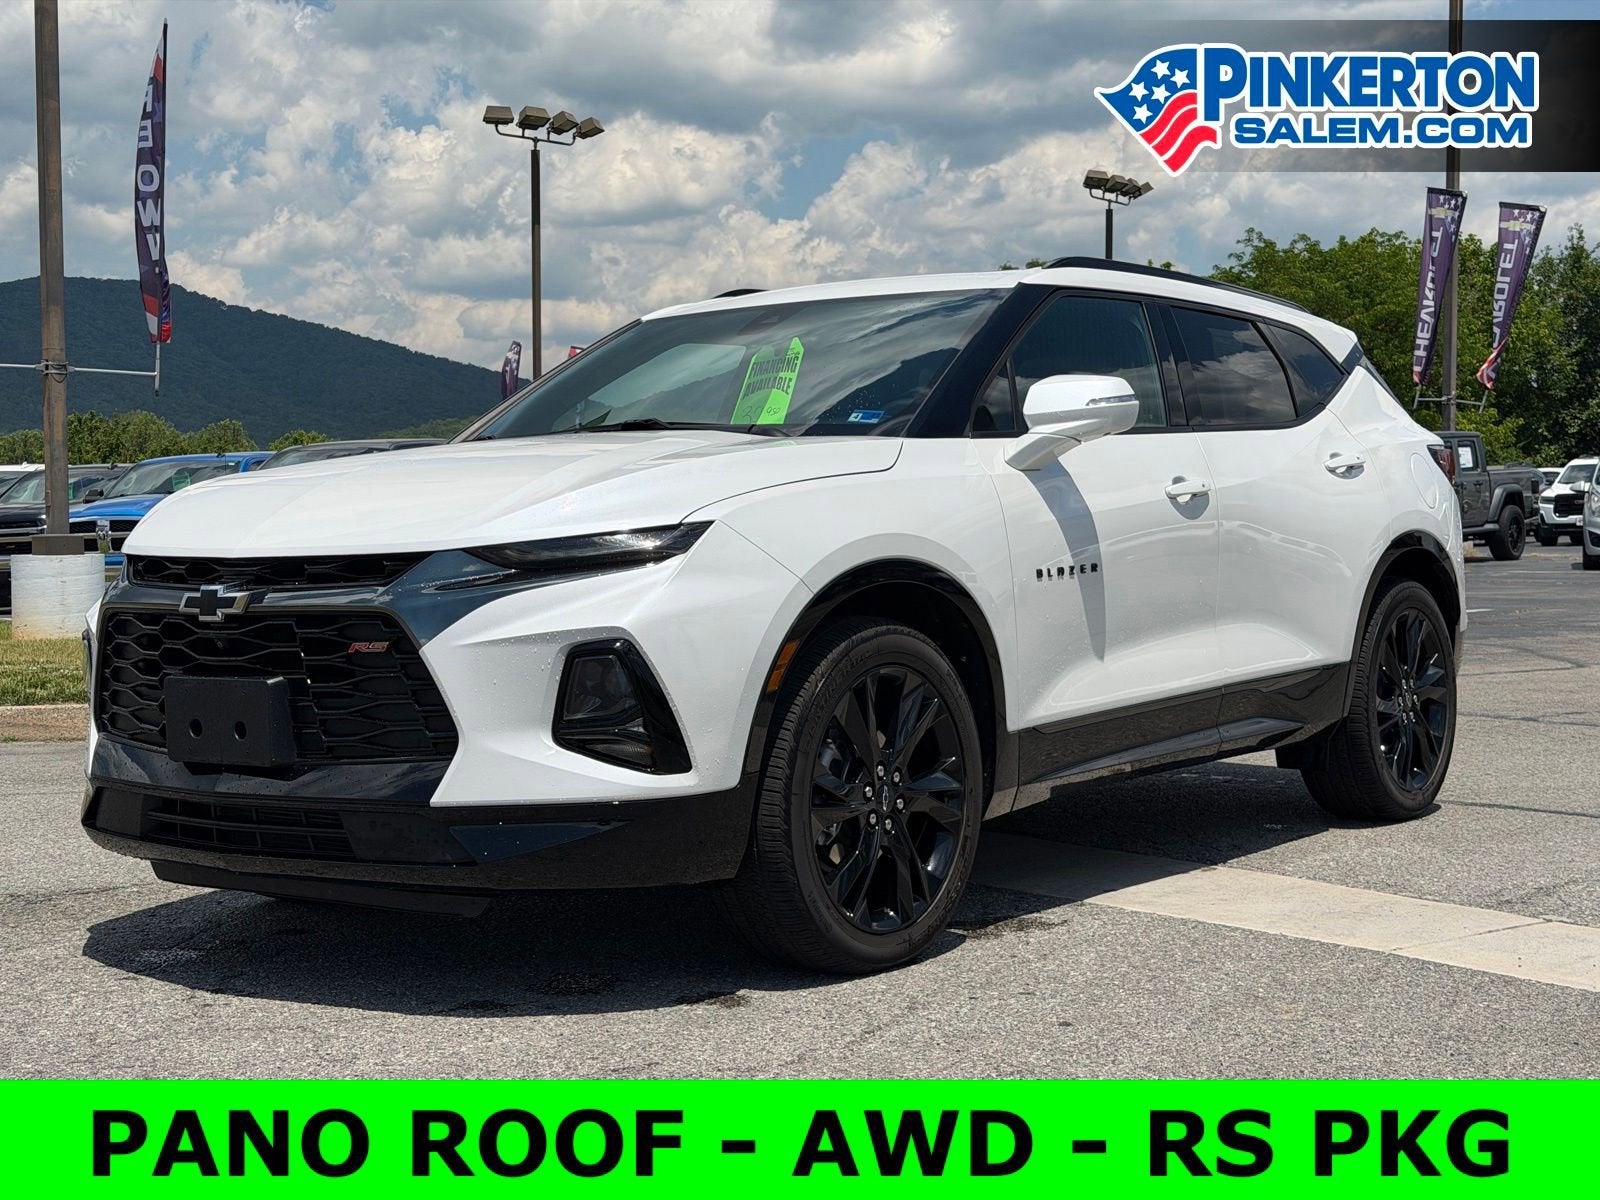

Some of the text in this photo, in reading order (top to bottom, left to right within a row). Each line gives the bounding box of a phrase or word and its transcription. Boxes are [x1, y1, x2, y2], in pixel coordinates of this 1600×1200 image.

[749, 355, 800, 378] FINANCING
[742, 376, 793, 399] AVAILABLE
[1036, 562, 1099, 580] BLAZER
[348, 641, 390, 653] RS
